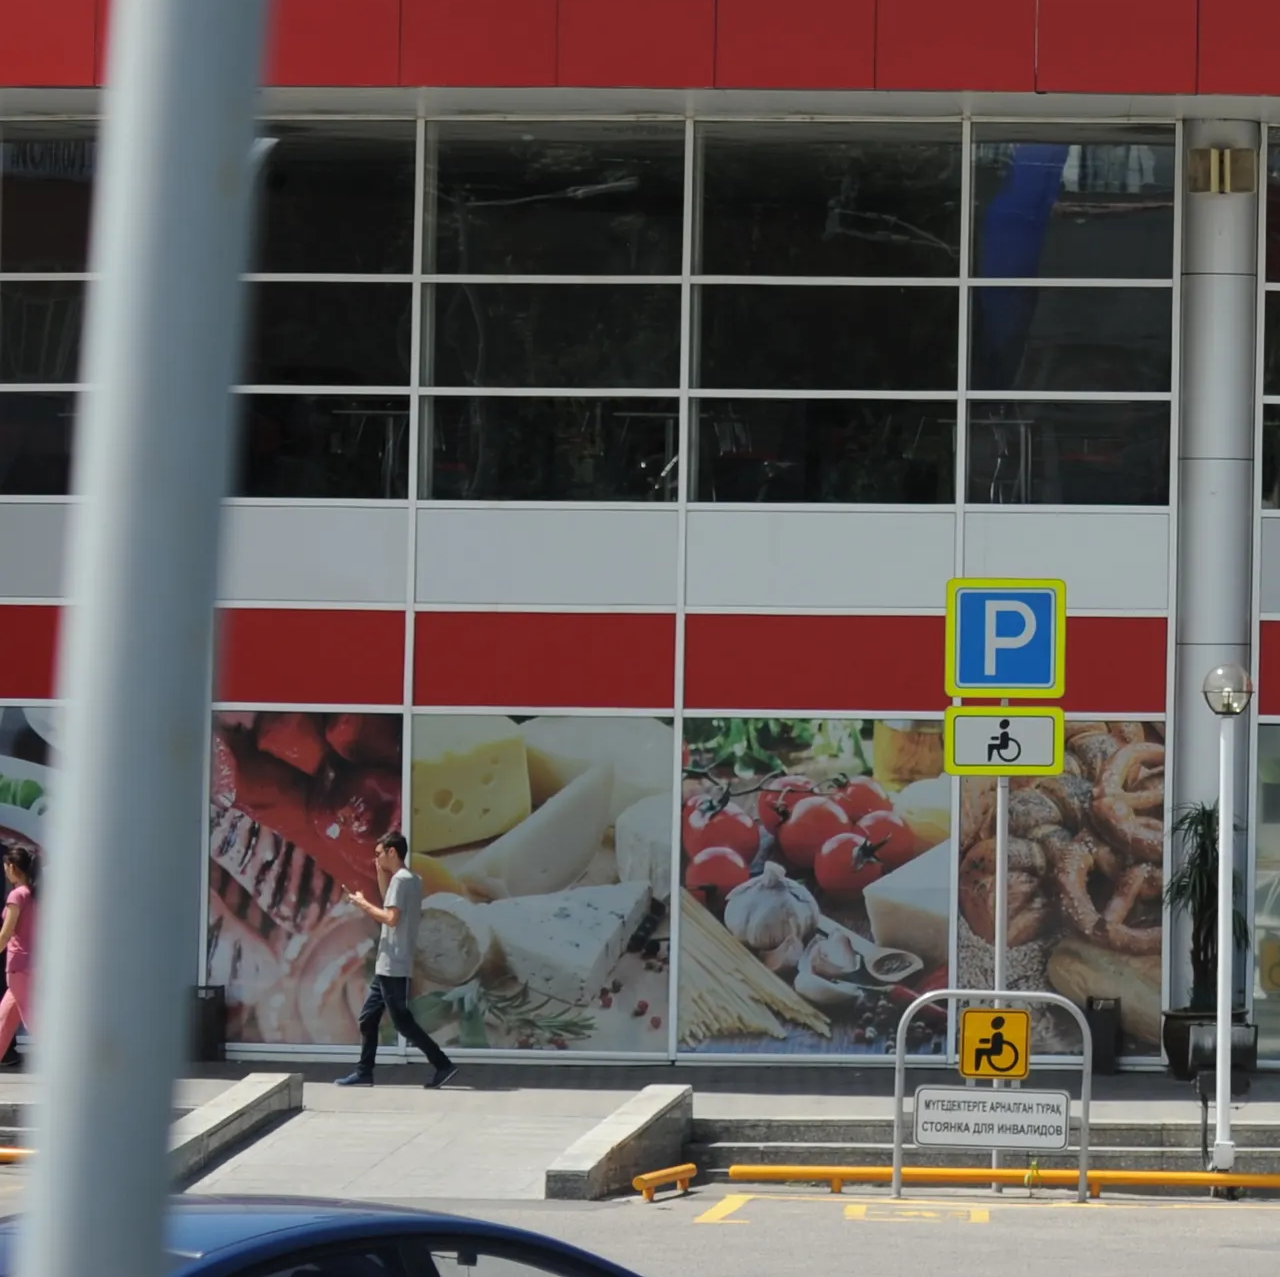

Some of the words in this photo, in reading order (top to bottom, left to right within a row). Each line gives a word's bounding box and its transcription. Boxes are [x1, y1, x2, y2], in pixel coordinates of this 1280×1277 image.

[986, 601, 1036, 675] P
[922, 1121, 970, 1133] СТОЯНКА
[972, 1122, 994, 1135] ДЛЯ
[997, 1123, 1063, 1137] ИНВАЛИДОВ
